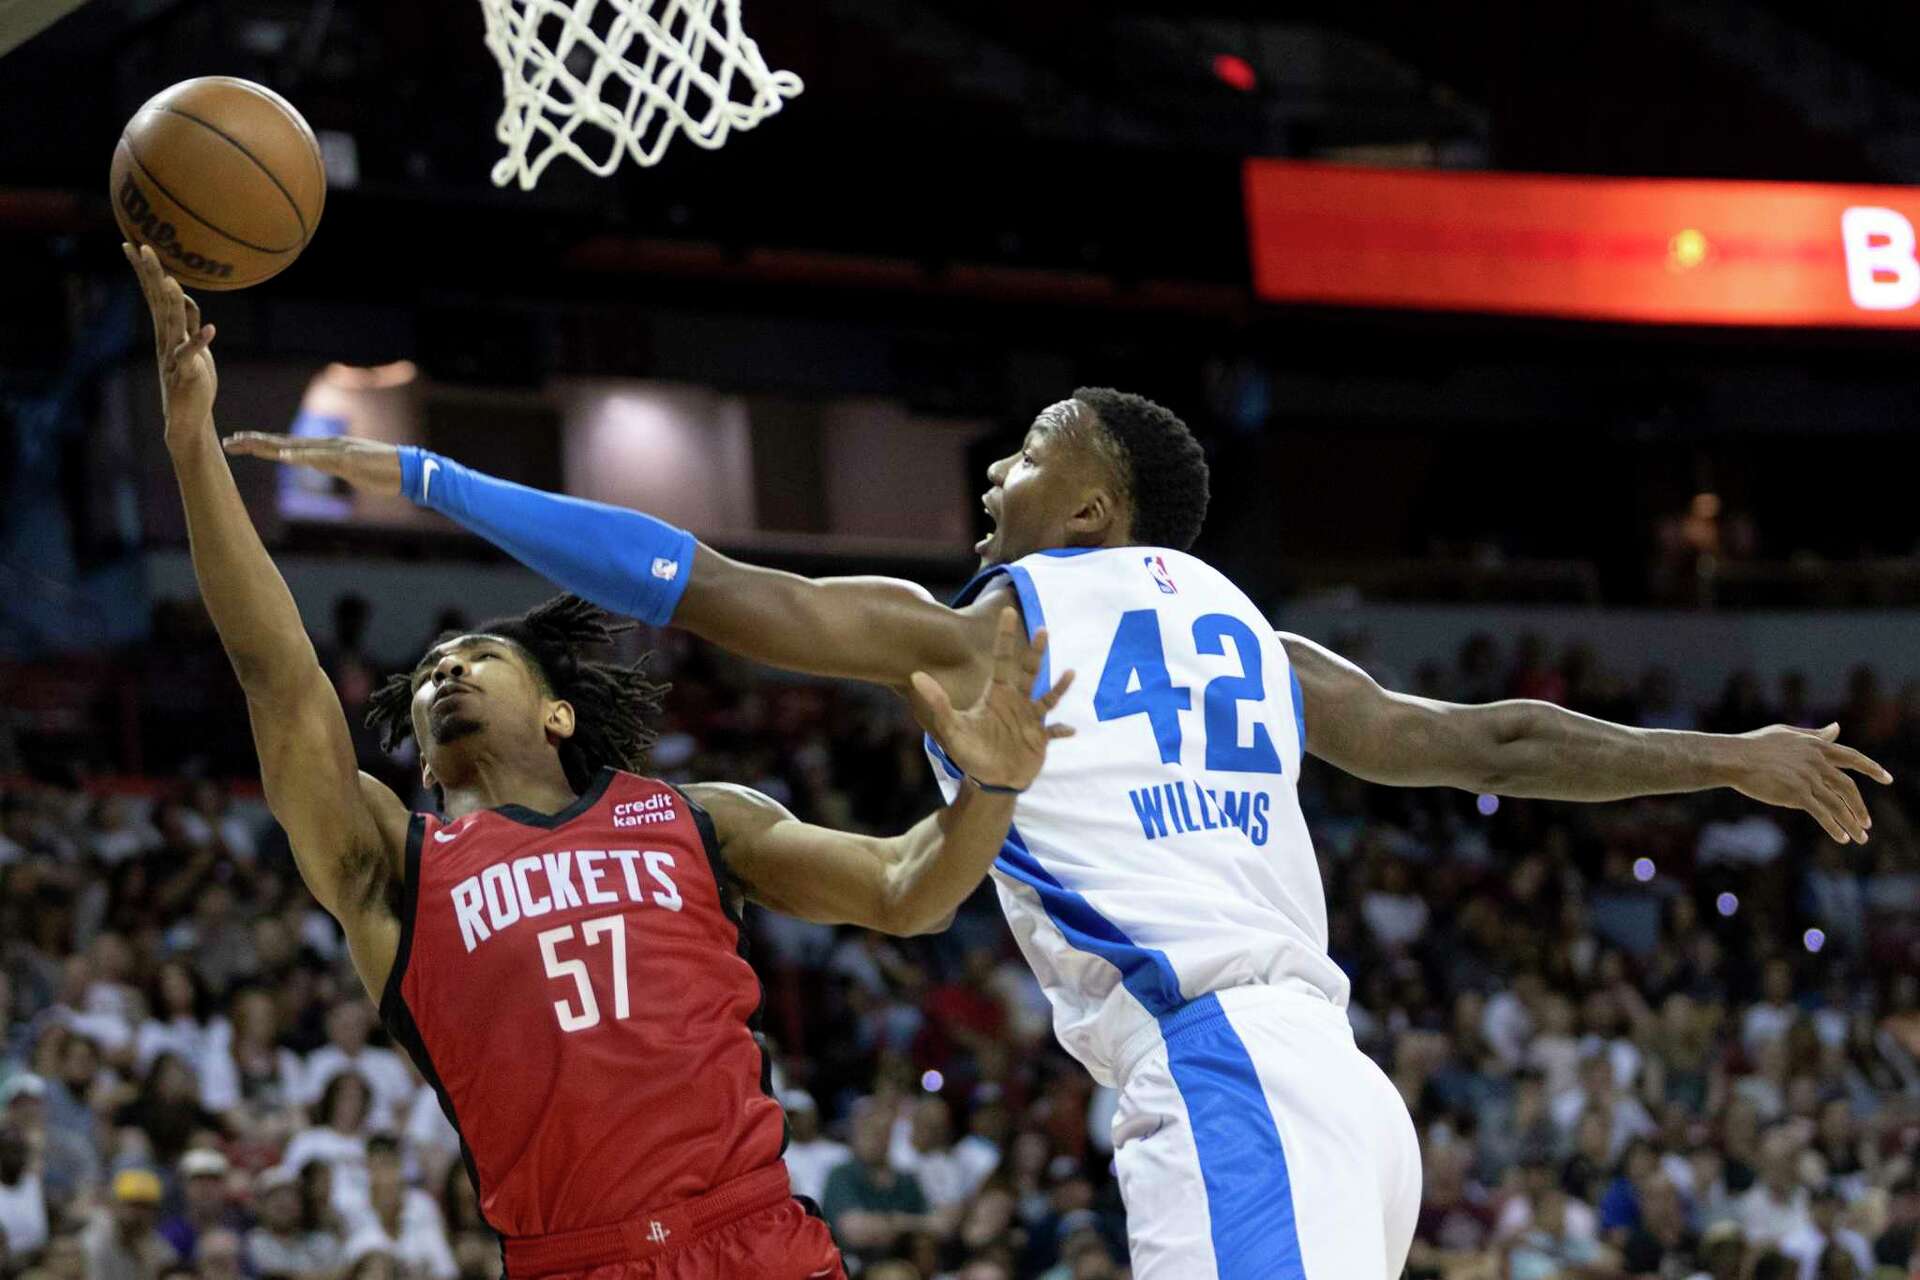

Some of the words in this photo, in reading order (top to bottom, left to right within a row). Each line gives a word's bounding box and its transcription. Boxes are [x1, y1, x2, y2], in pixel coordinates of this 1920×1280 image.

[119, 171, 234, 278] Wilson
[1841, 206, 1920, 310] B
[1094, 609, 1282, 774] 42
[613, 809, 676, 828] karma
[614, 793, 673, 815] credit
[1128, 779, 1270, 846] WILLMS
[450, 850, 683, 954] ROCKETS
[537, 914, 630, 1033] 57
